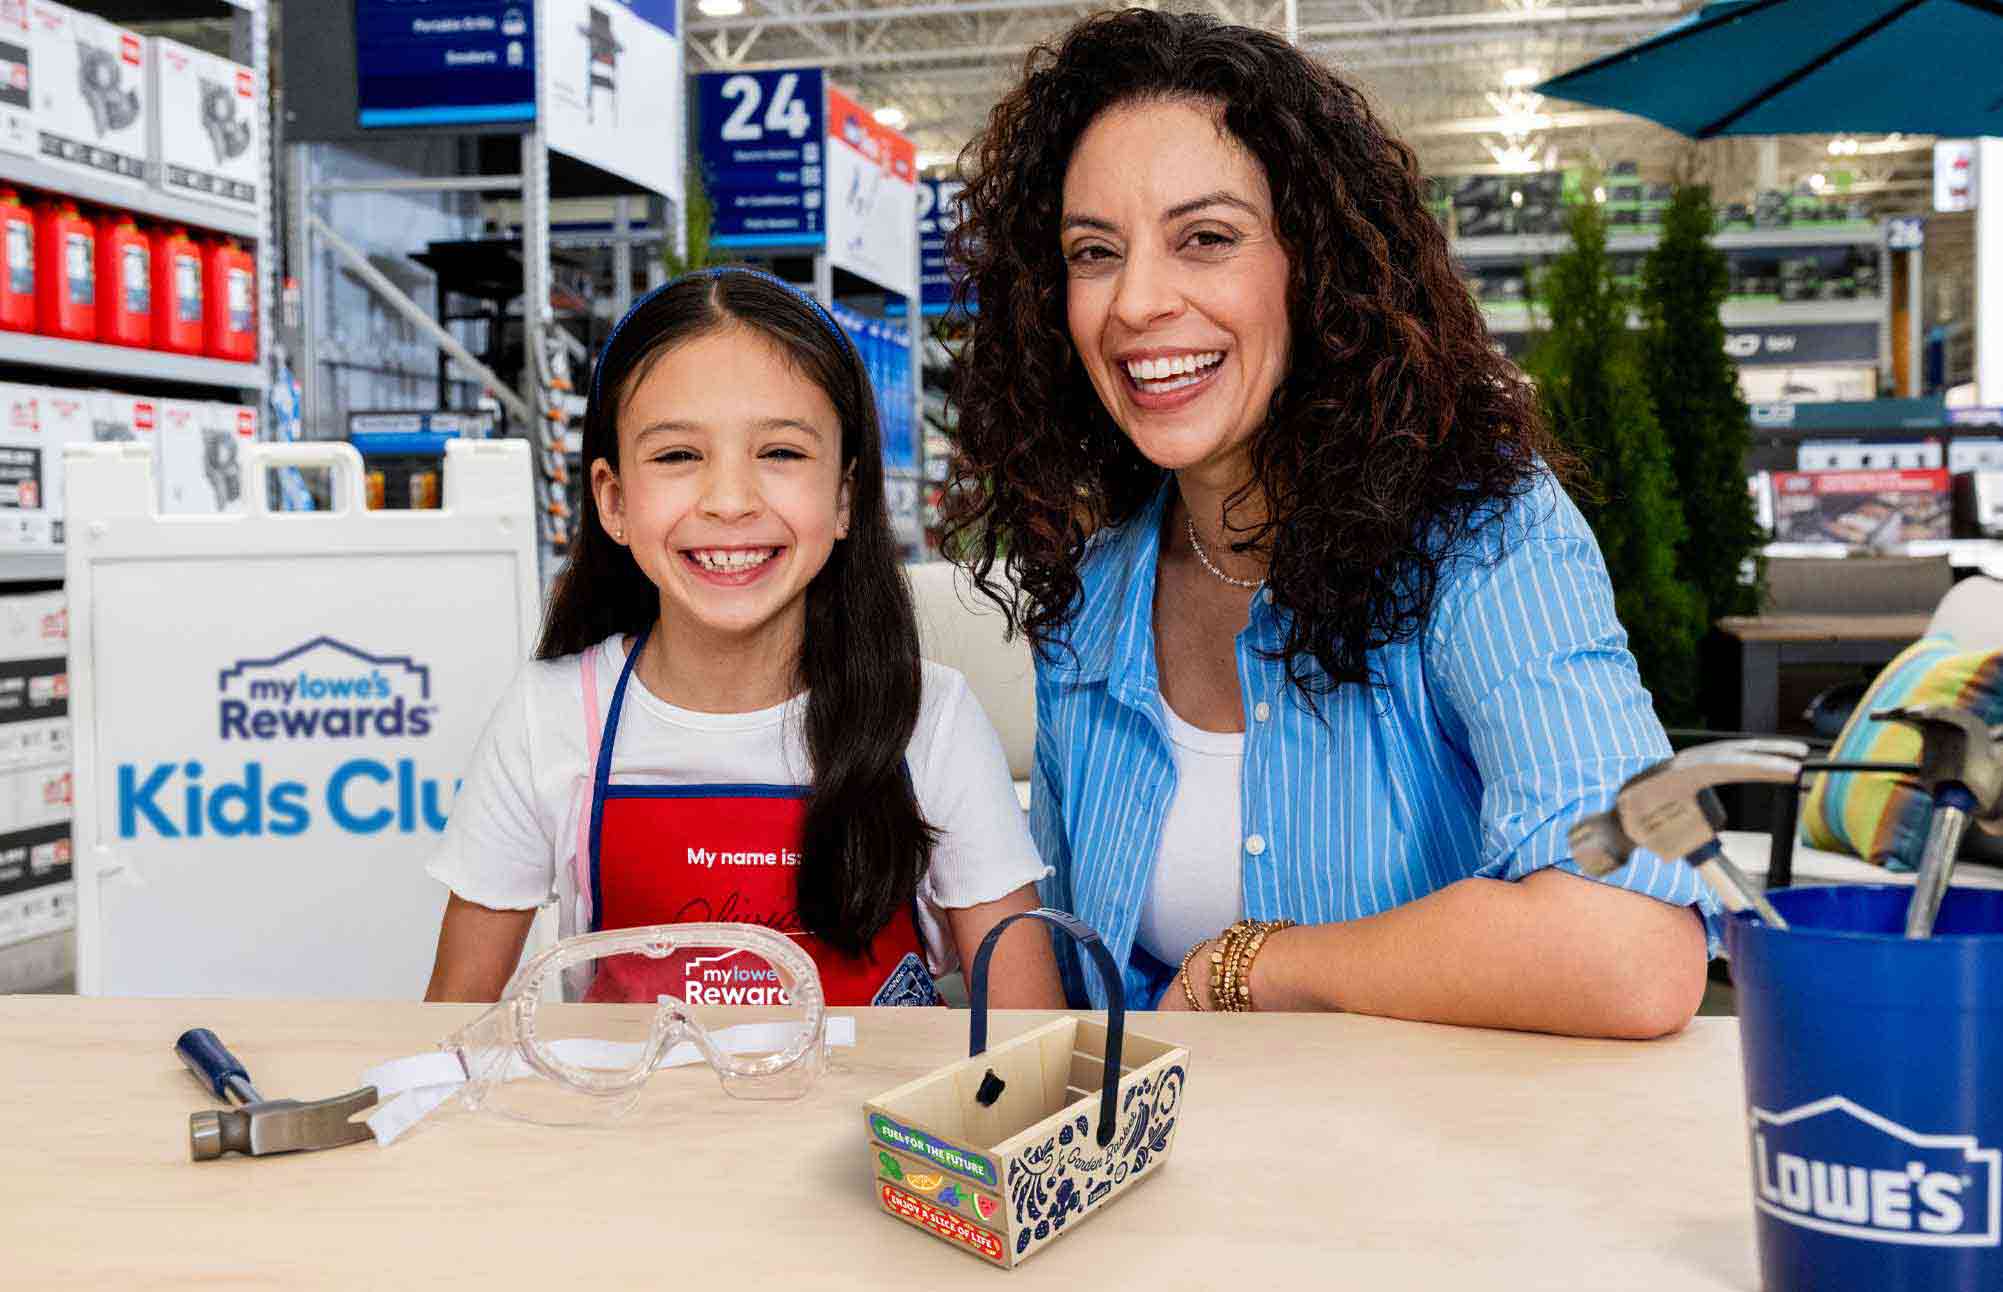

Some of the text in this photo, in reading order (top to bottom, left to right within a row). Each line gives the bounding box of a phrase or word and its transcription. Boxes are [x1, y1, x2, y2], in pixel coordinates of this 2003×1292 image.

[720, 72, 812, 142] 24
[117, 758, 311, 838] Kids
[325, 757, 464, 835] Clu
[687, 847, 716, 869] My
[721, 852, 777, 866] name
[703, 965, 779, 985] mylowe
[882, 1126, 986, 1176] FUEL FOR THE FUTURE
[1754, 1132, 1967, 1234] LOWE'S
[890, 1195, 993, 1249] ENJOY A SLICE OF LIFE
